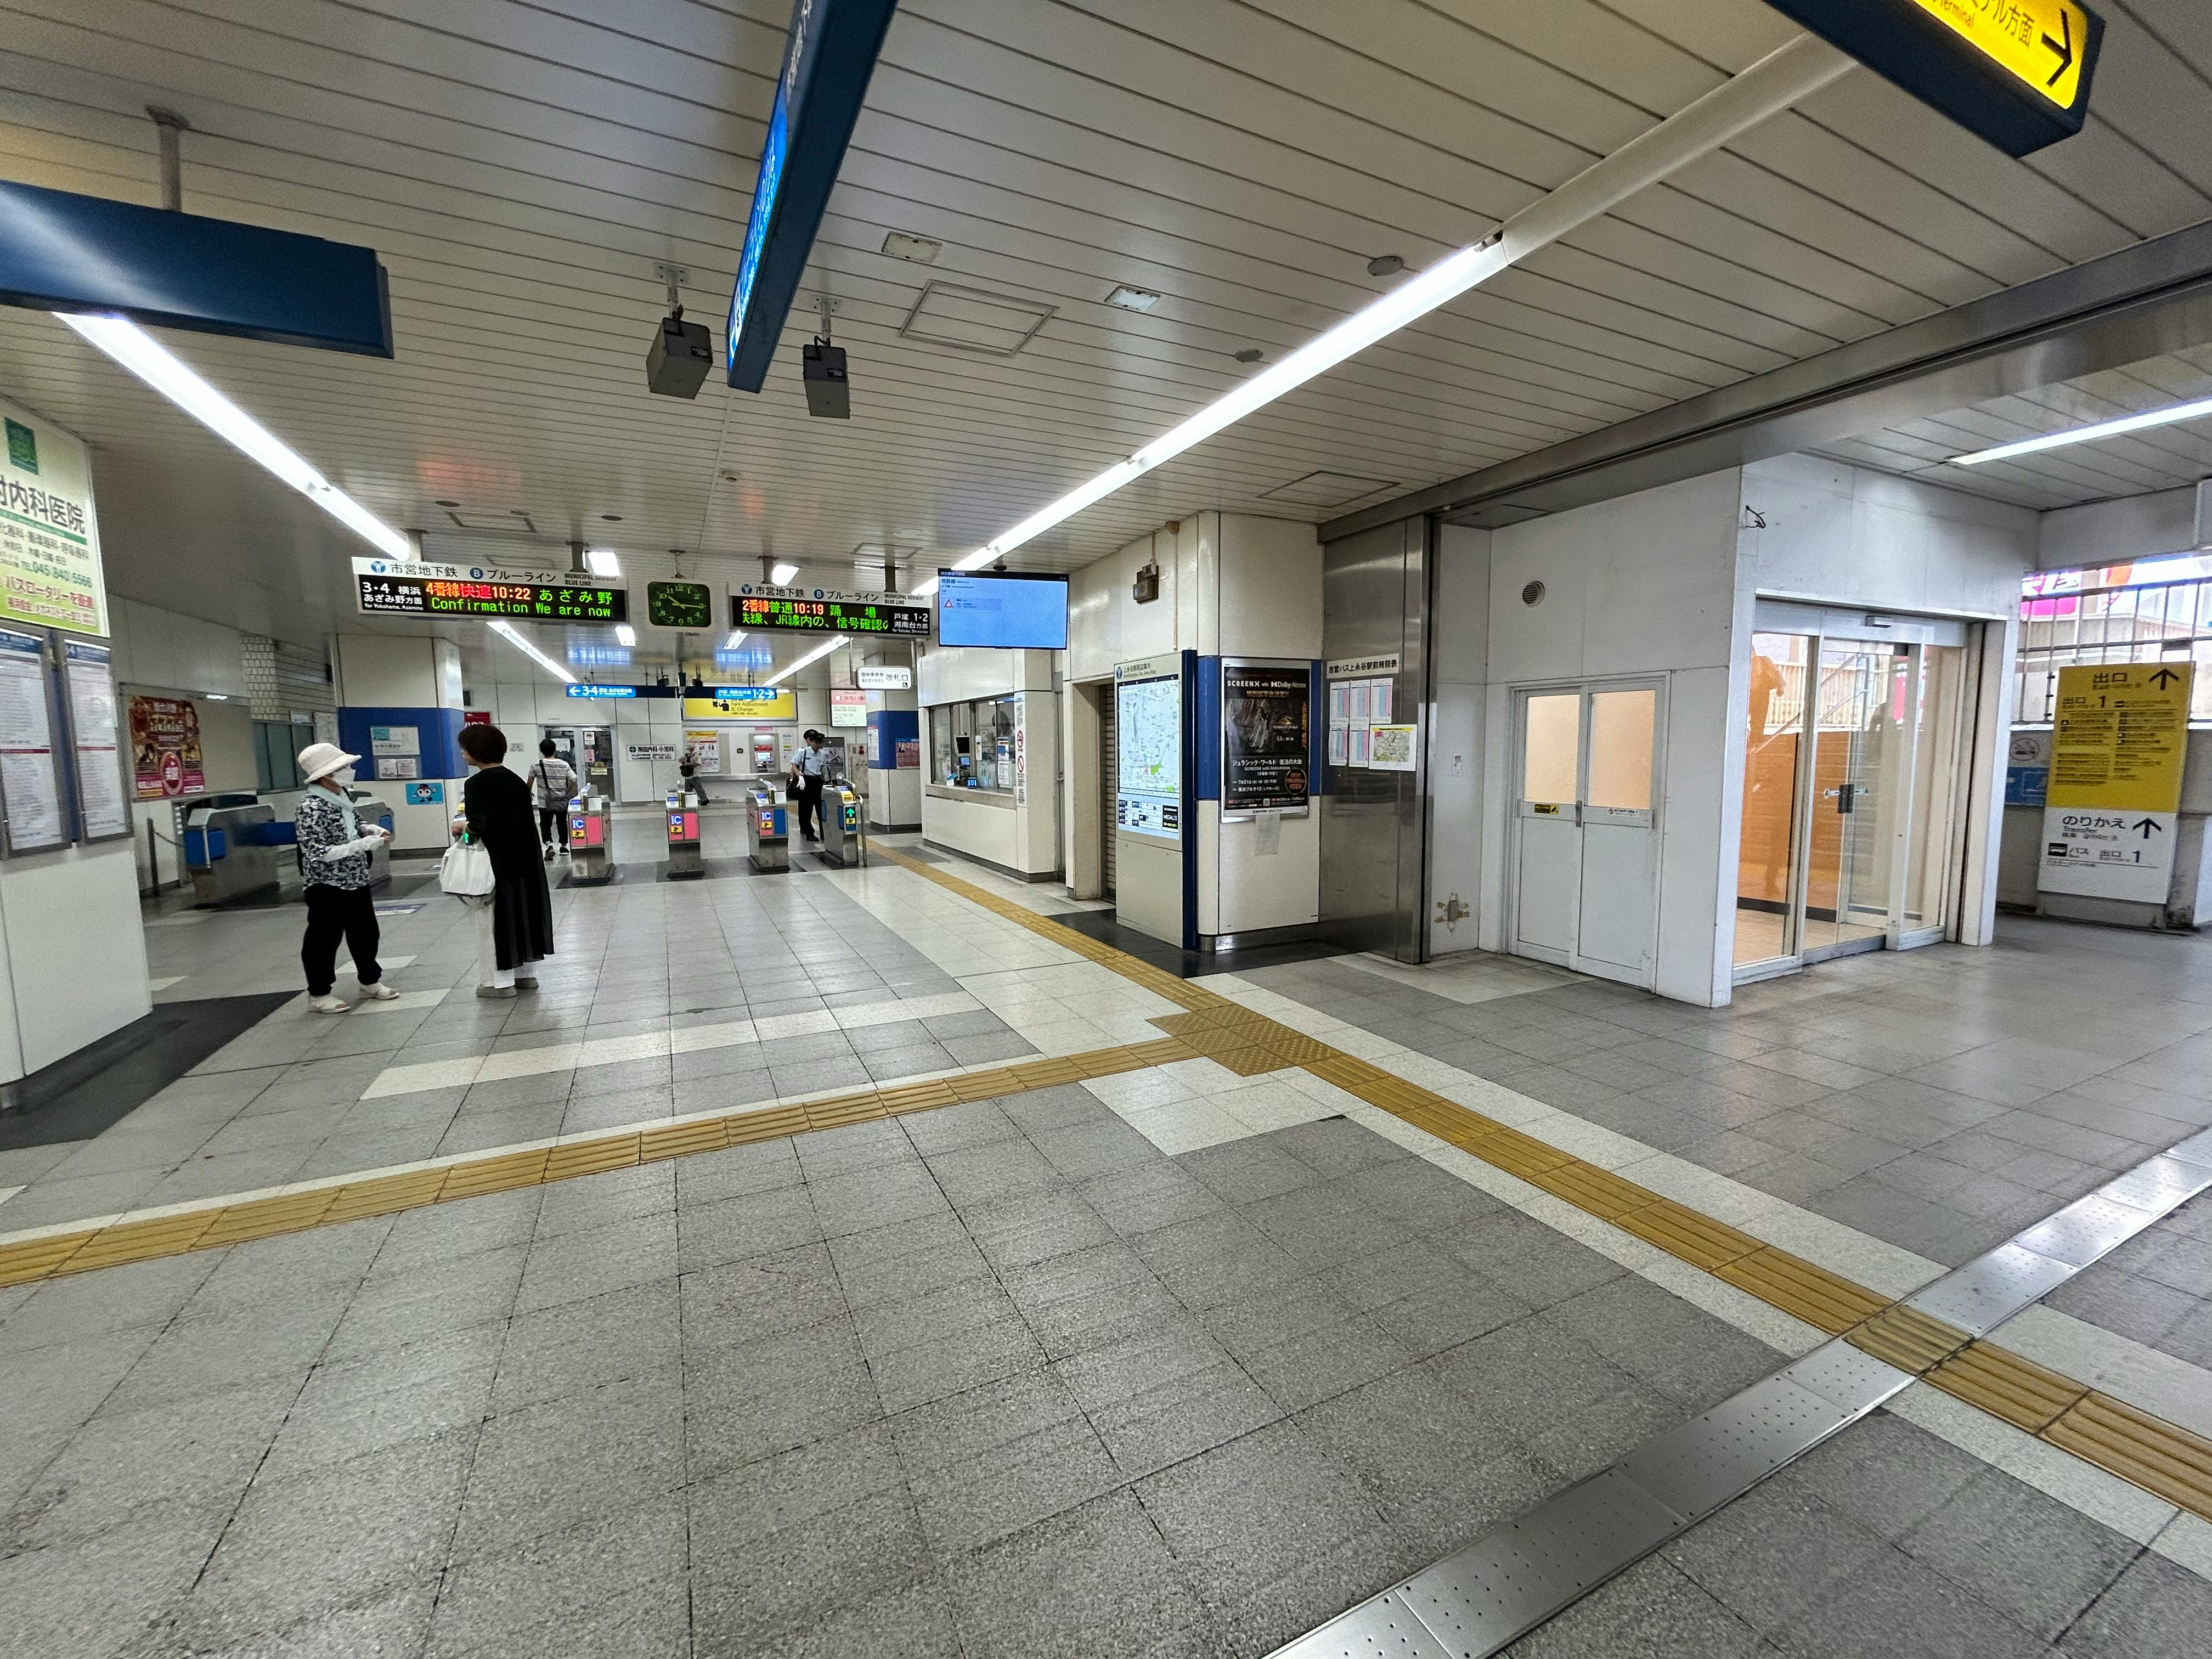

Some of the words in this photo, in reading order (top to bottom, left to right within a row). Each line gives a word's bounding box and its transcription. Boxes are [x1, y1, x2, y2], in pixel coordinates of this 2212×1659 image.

[390, 563, 458, 577] 市営地下鉄
[487, 569, 556, 583] ブルーライン
[398, 585, 422, 595] 横浜
[755, 585, 805, 598] 市営地下鉄
[364, 594, 423, 605] あざみ野方面
[827, 590, 878, 602] ブルーライン
[431, 596, 528, 614] Confirmation
[535, 602, 551, 614] We
[558, 606, 581, 616] are
[588, 607, 611, 617] now
[894, 613, 909, 621] 戸塚
[894, 620, 928, 629] 湘南台方面
[885, 673, 909, 681] 改札口
[2093, 673, 2127, 684] 出口
[2098, 695, 2106, 708] 1
[671, 815, 681, 825] IC
[761, 812, 772, 821] IC
[572, 819, 584, 829] IC
[2062, 816, 2126, 829] のりかえ
[2133, 850, 2140, 864] 1
